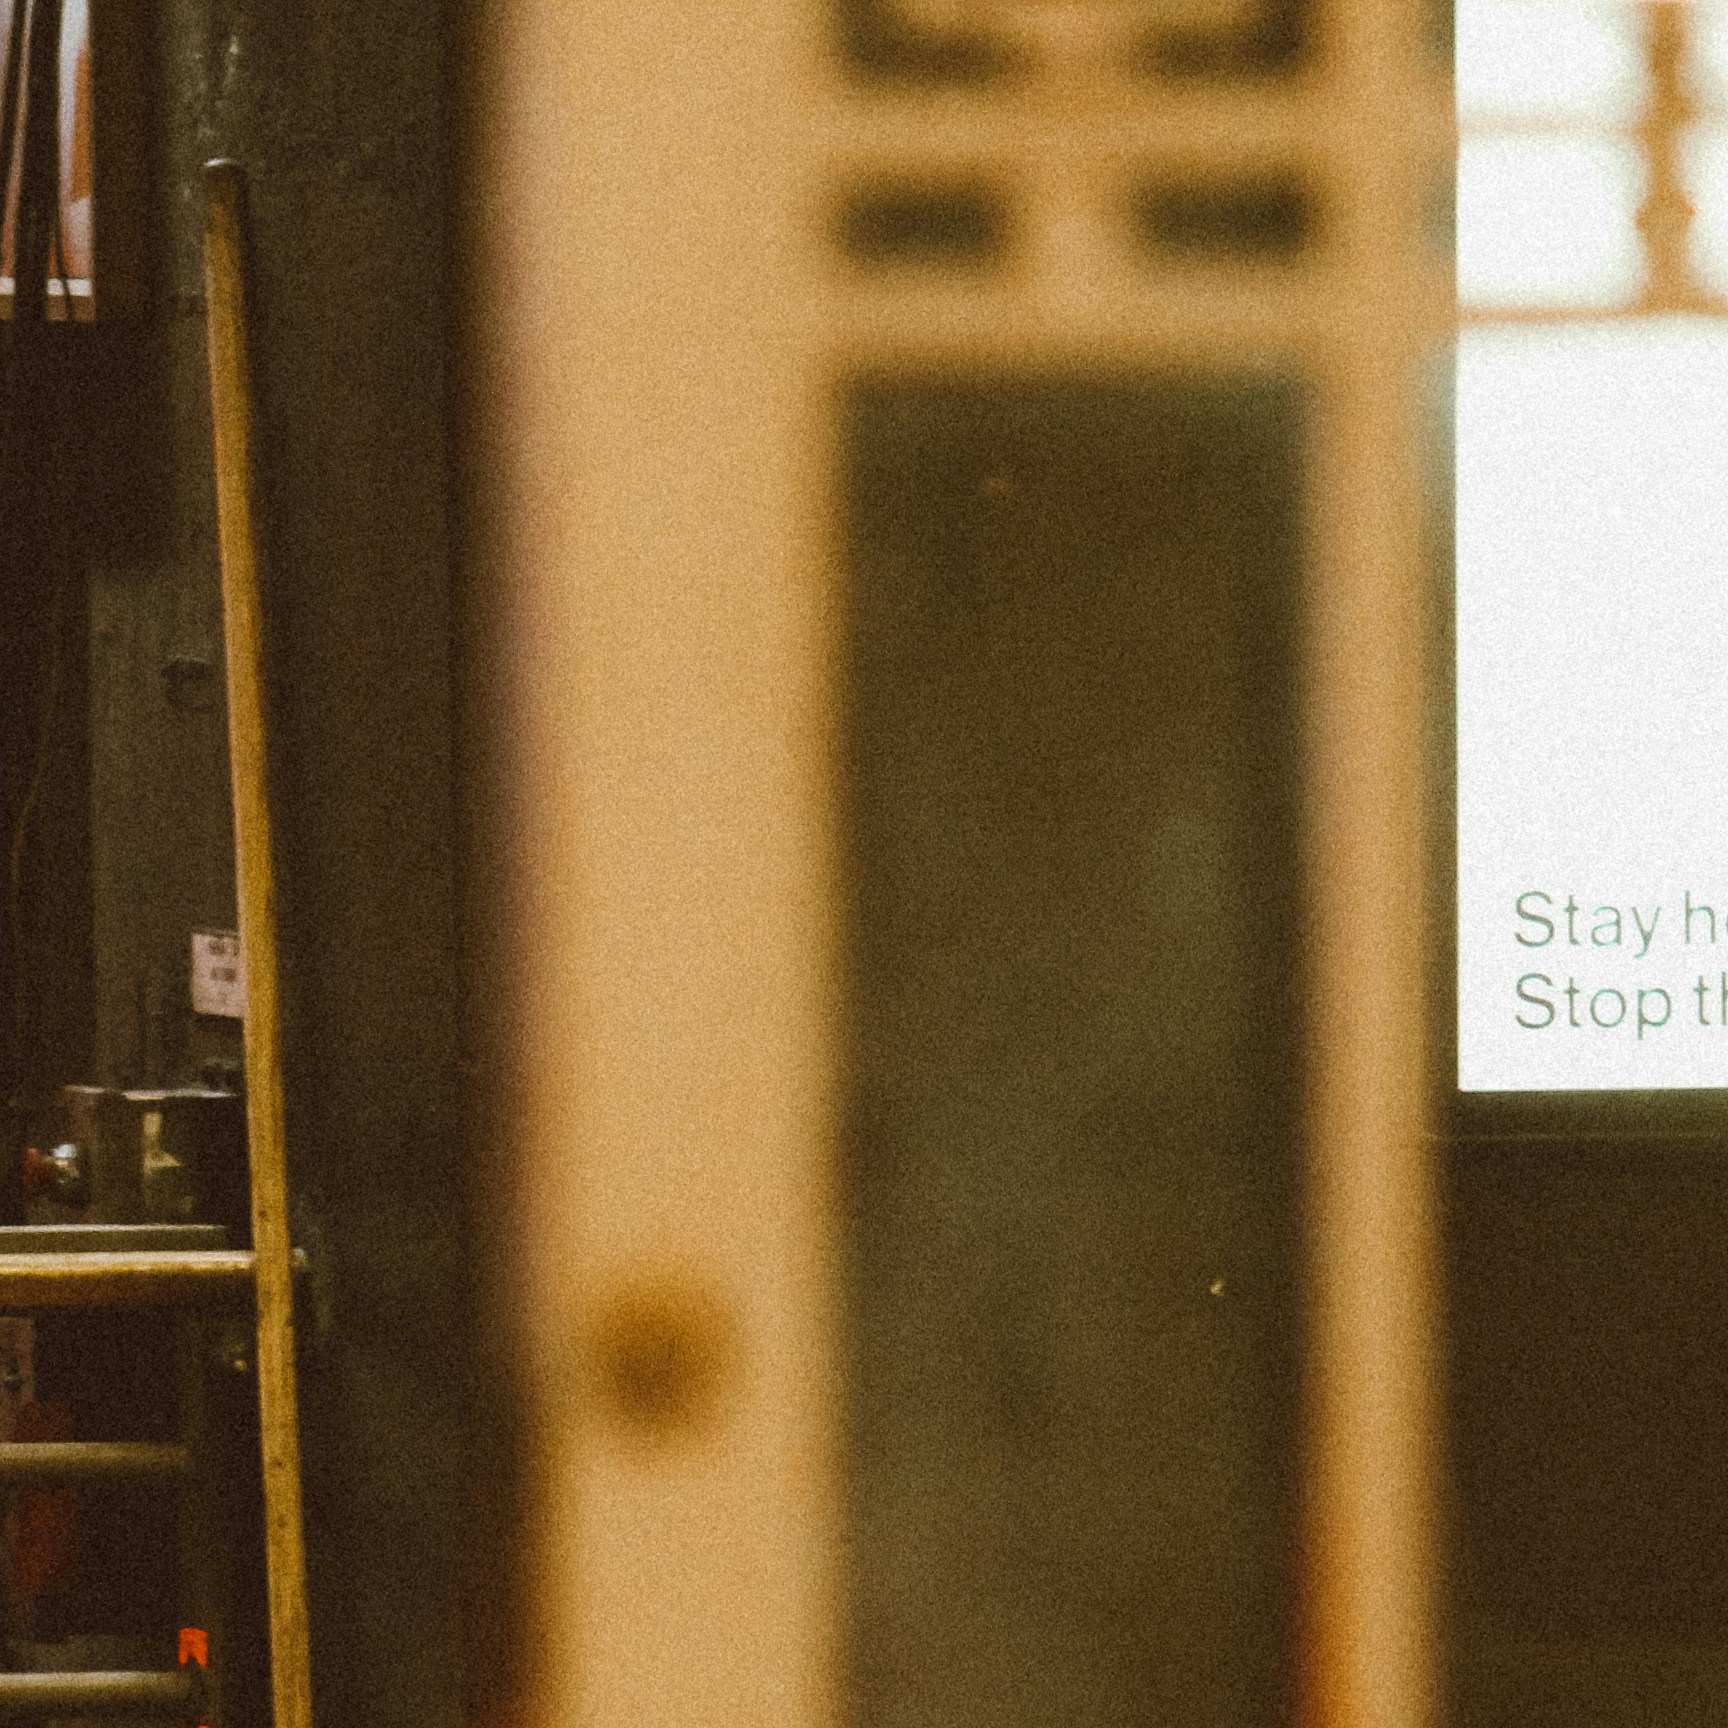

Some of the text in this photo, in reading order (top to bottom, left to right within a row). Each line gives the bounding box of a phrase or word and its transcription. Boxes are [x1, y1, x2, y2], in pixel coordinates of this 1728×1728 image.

[1514, 889, 1728, 959] Stay h
[1514, 972, 1674, 1041] Stop
